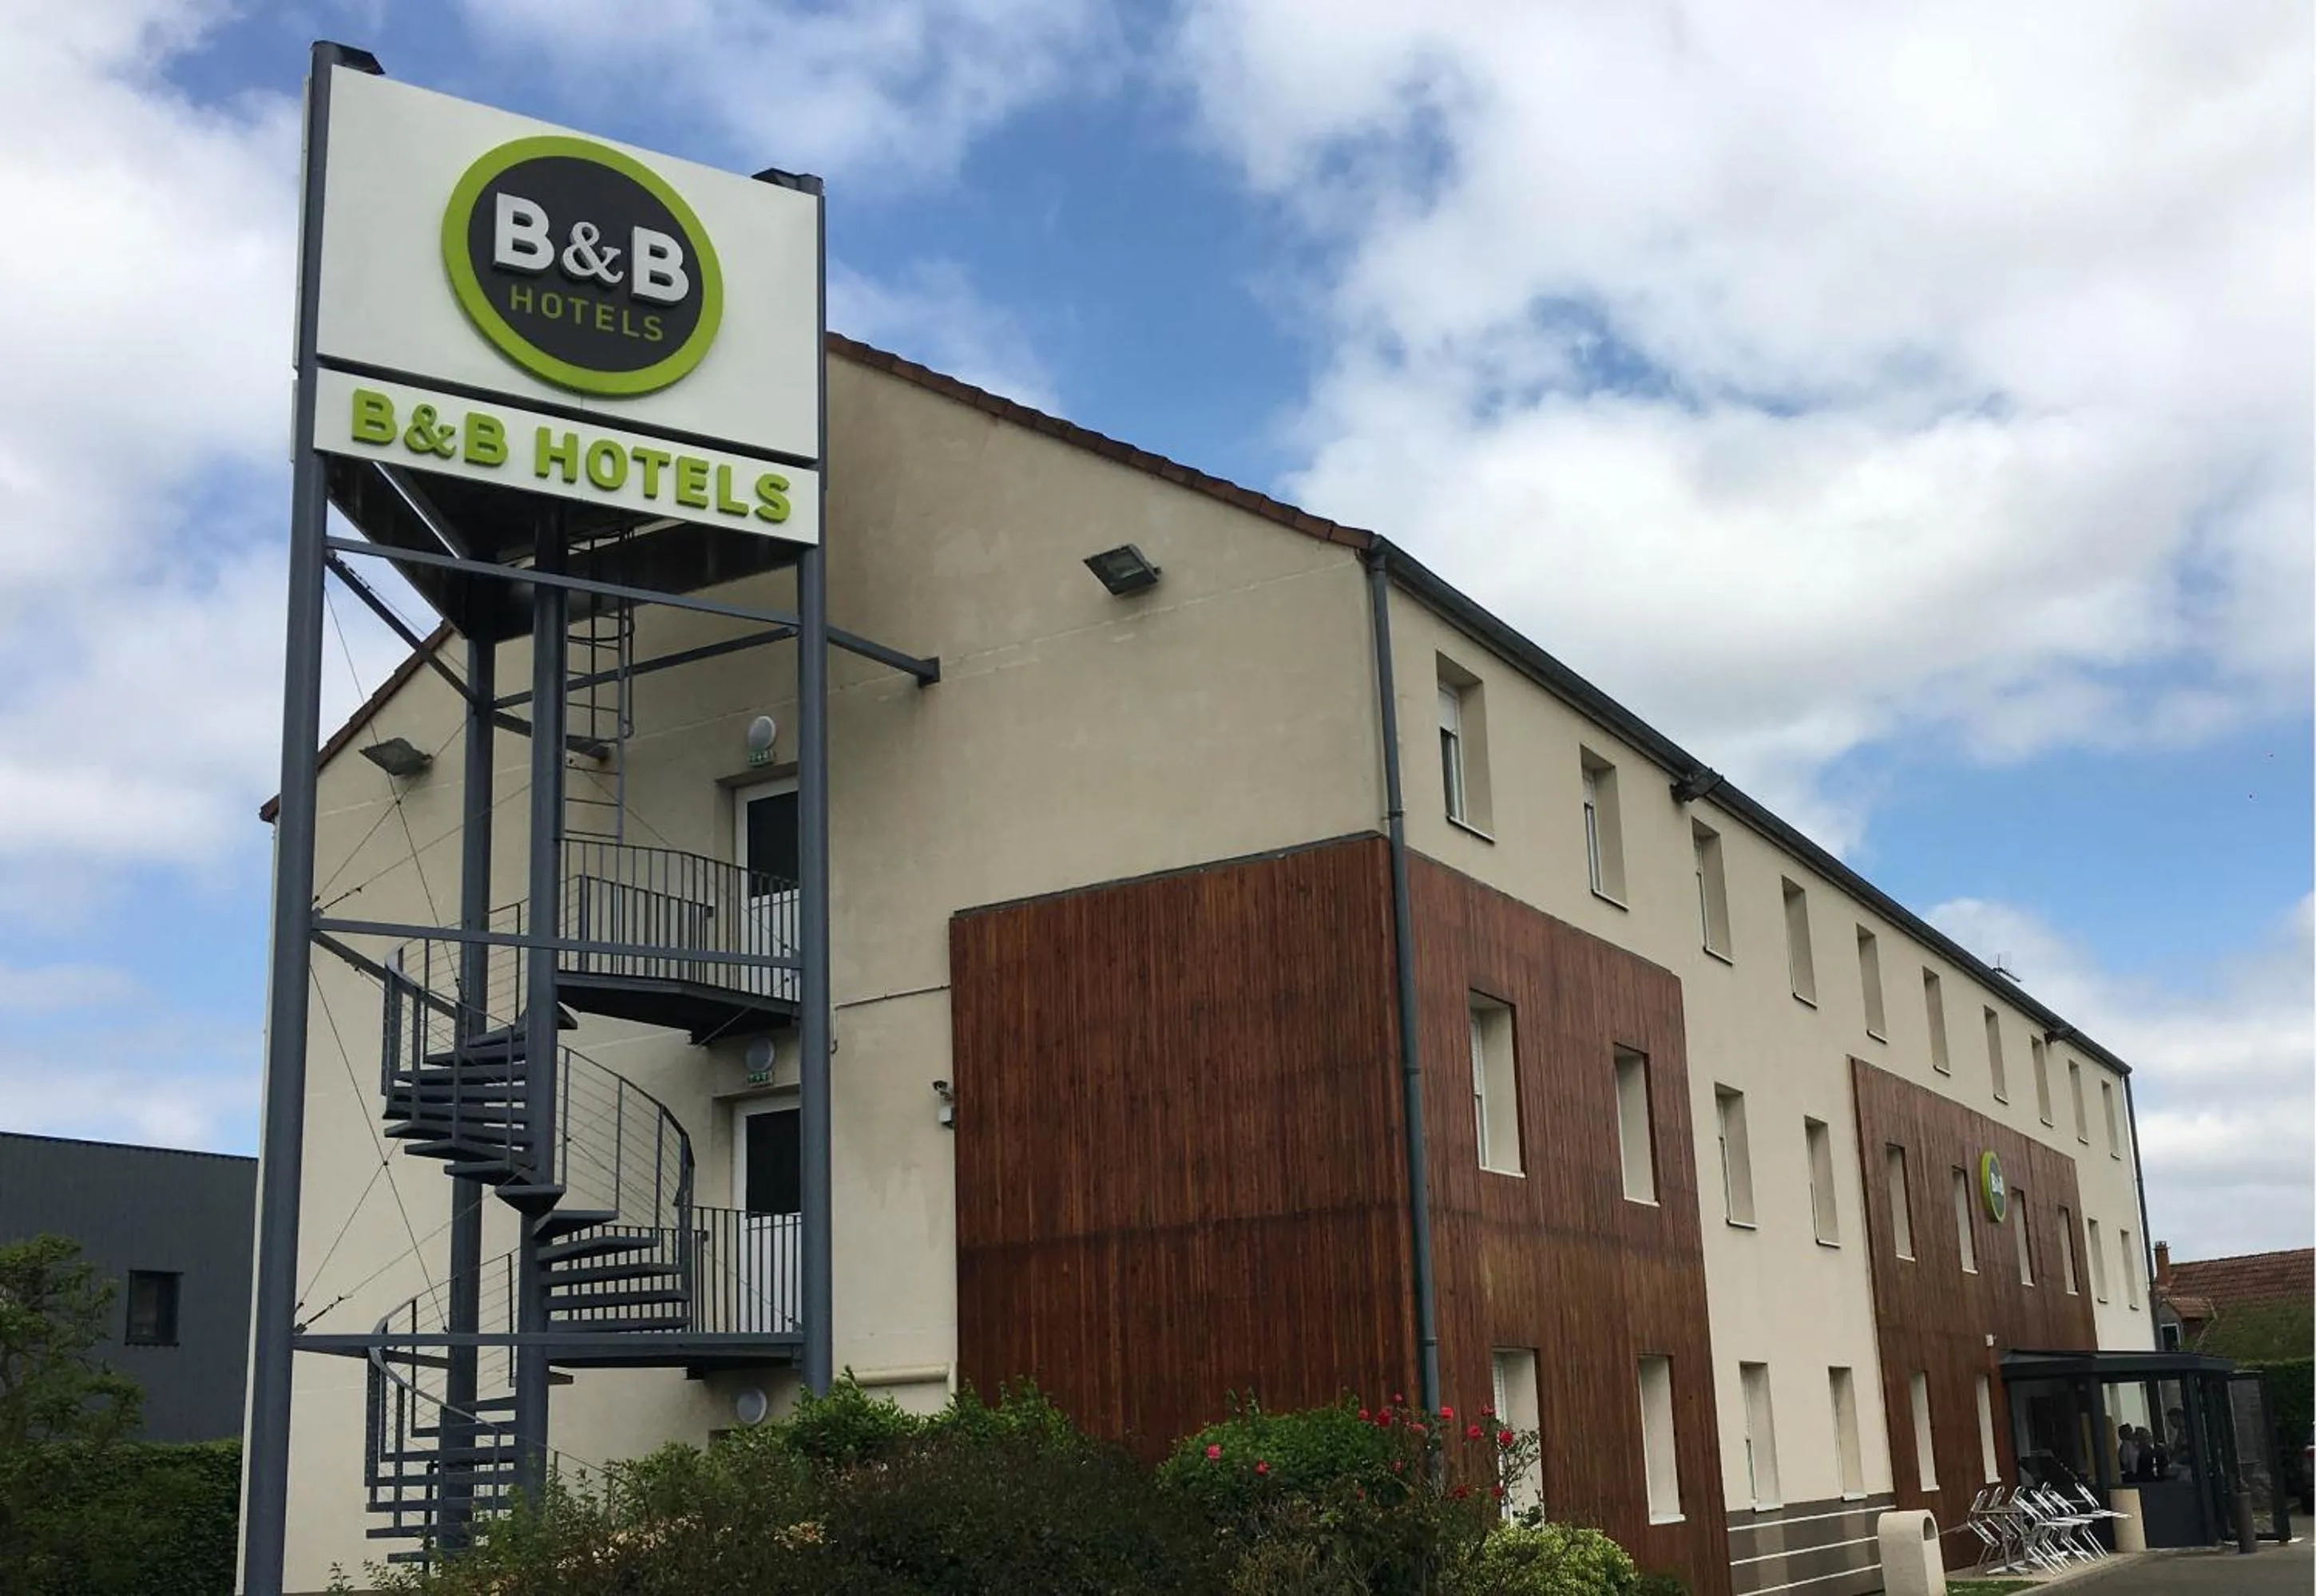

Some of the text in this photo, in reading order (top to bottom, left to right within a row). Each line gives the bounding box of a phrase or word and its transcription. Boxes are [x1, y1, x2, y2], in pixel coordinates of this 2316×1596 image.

[494, 192, 689, 303] B&B
[510, 285, 663, 342] HOTELS
[351, 389, 791, 524] B&B HOTELS
